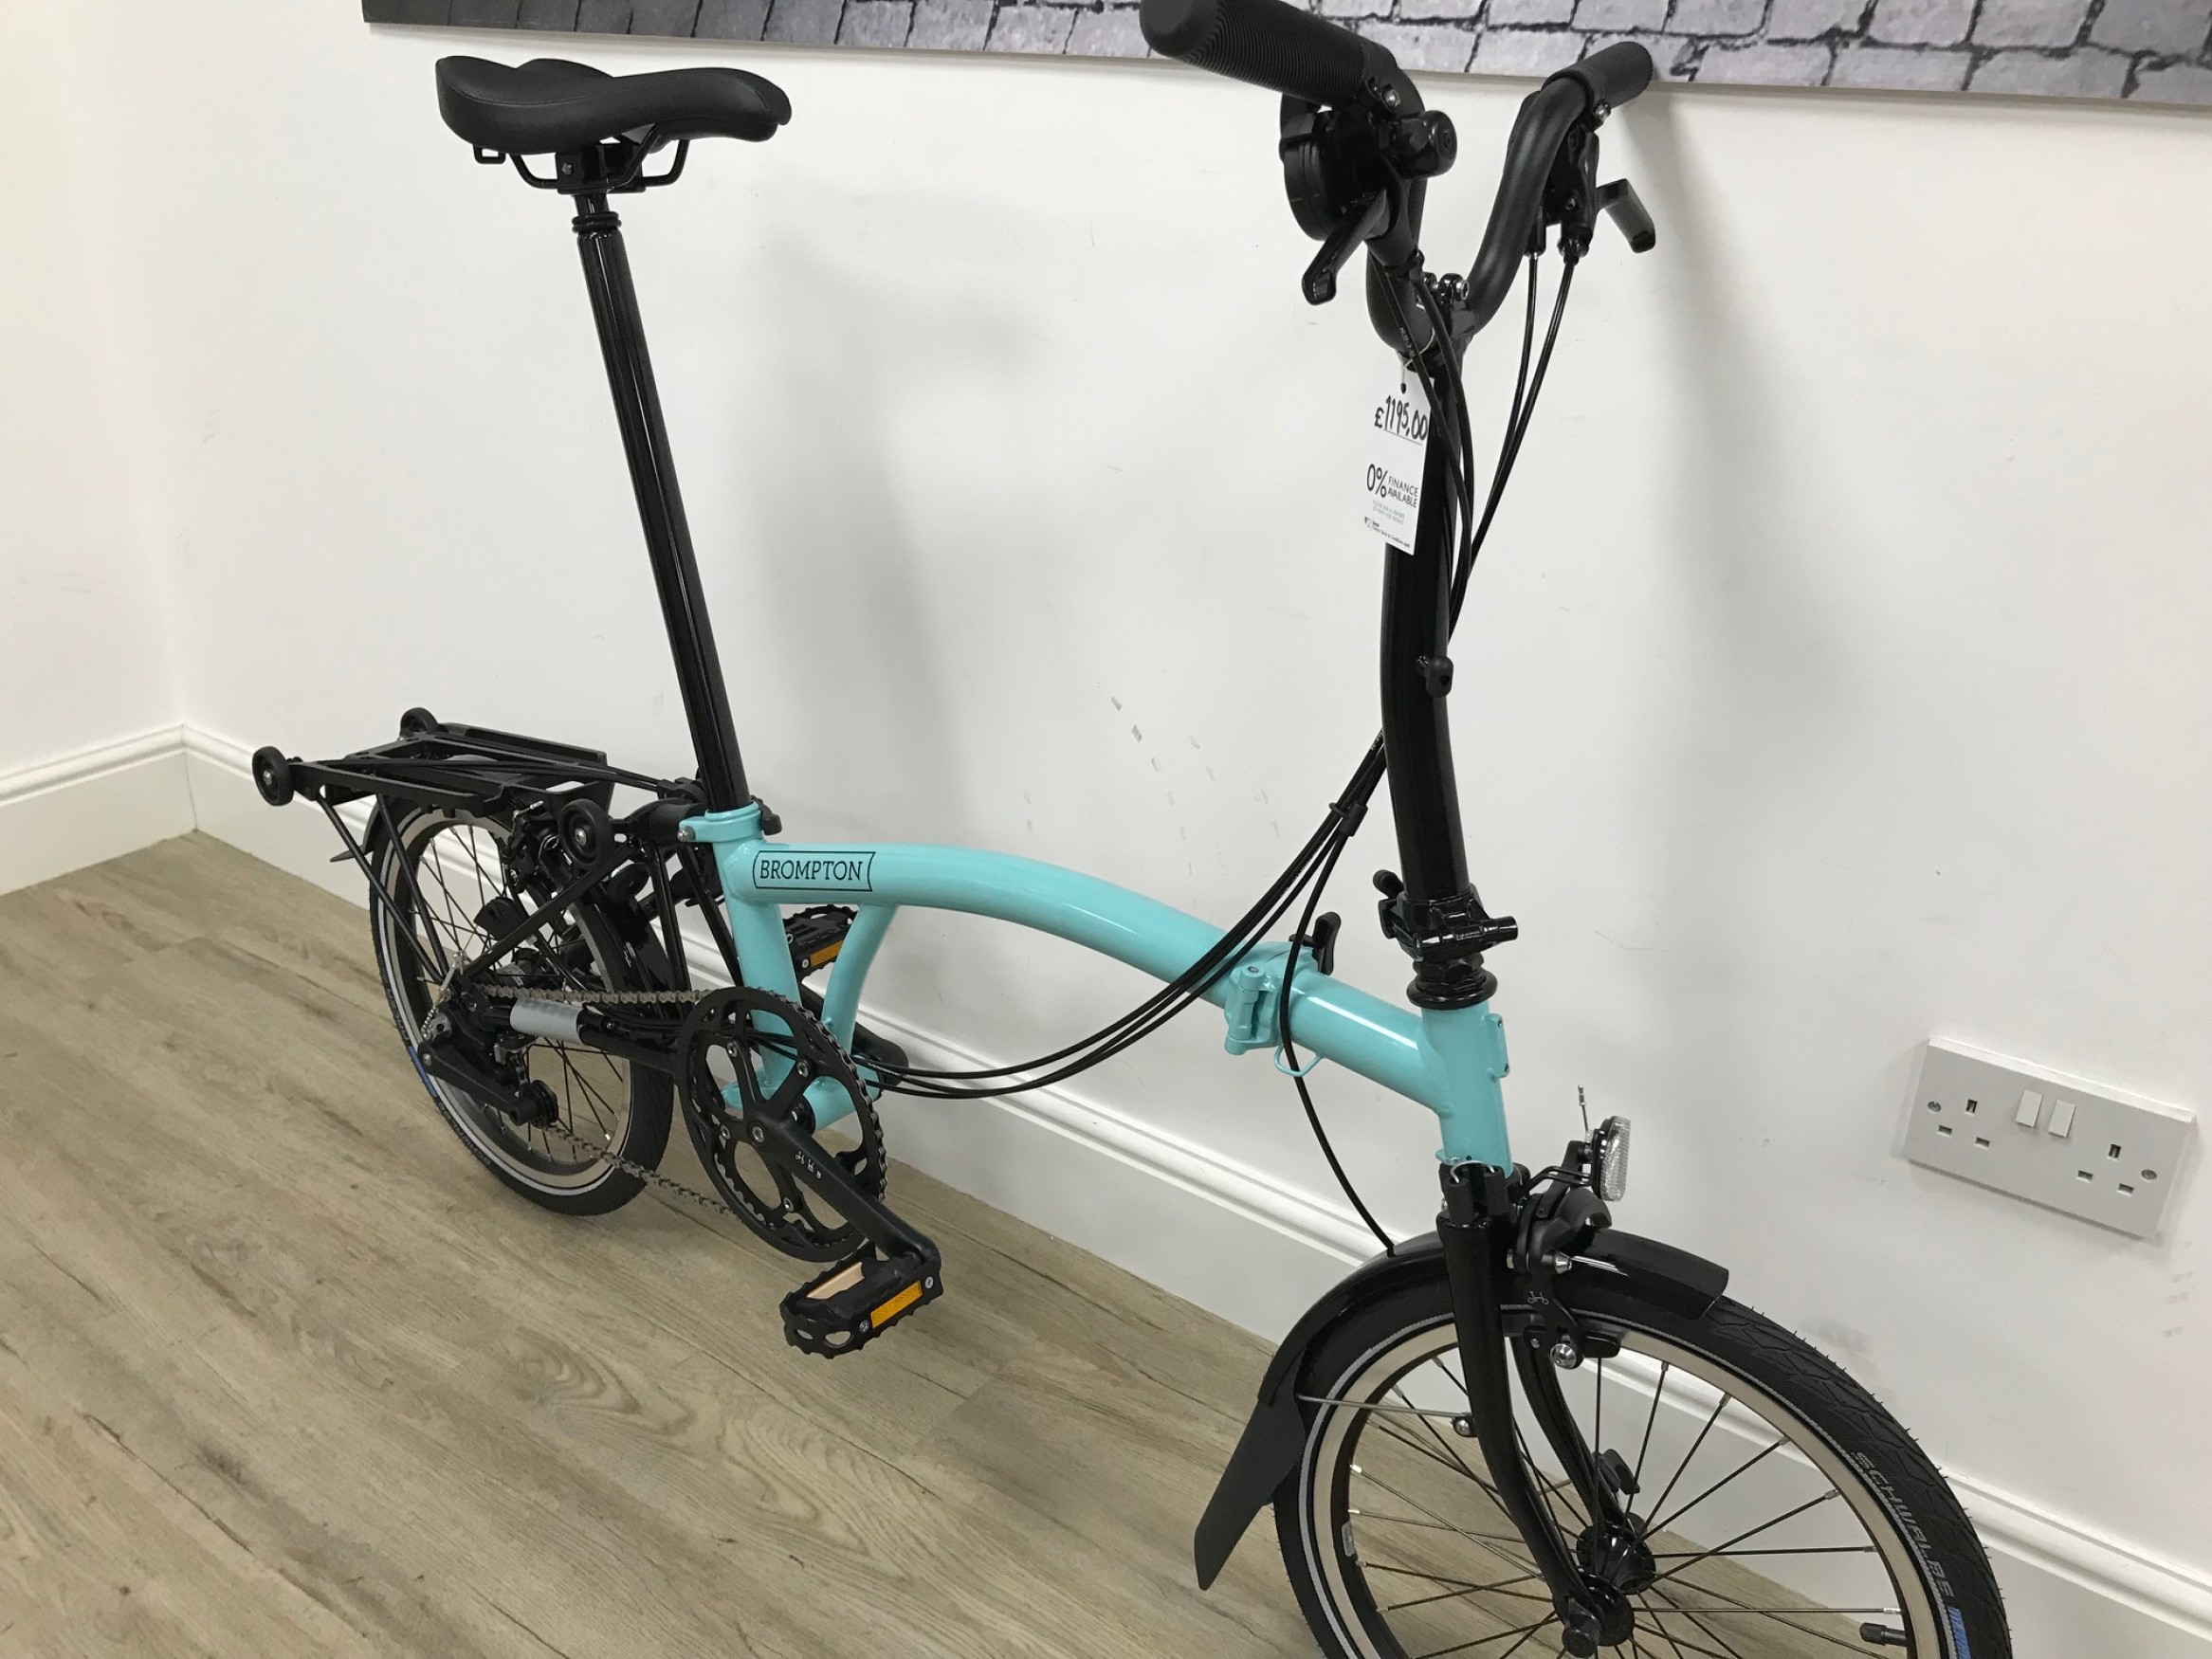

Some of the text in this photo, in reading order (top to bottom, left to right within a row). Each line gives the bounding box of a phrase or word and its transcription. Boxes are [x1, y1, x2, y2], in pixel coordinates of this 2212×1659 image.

[1367, 464, 1417, 498] 0% FINANCE
[1388, 487, 1417, 508] AVAILABLE
[760, 860, 863, 881] BROMPTON
[1851, 1451, 1954, 1597] SCHWALBE
